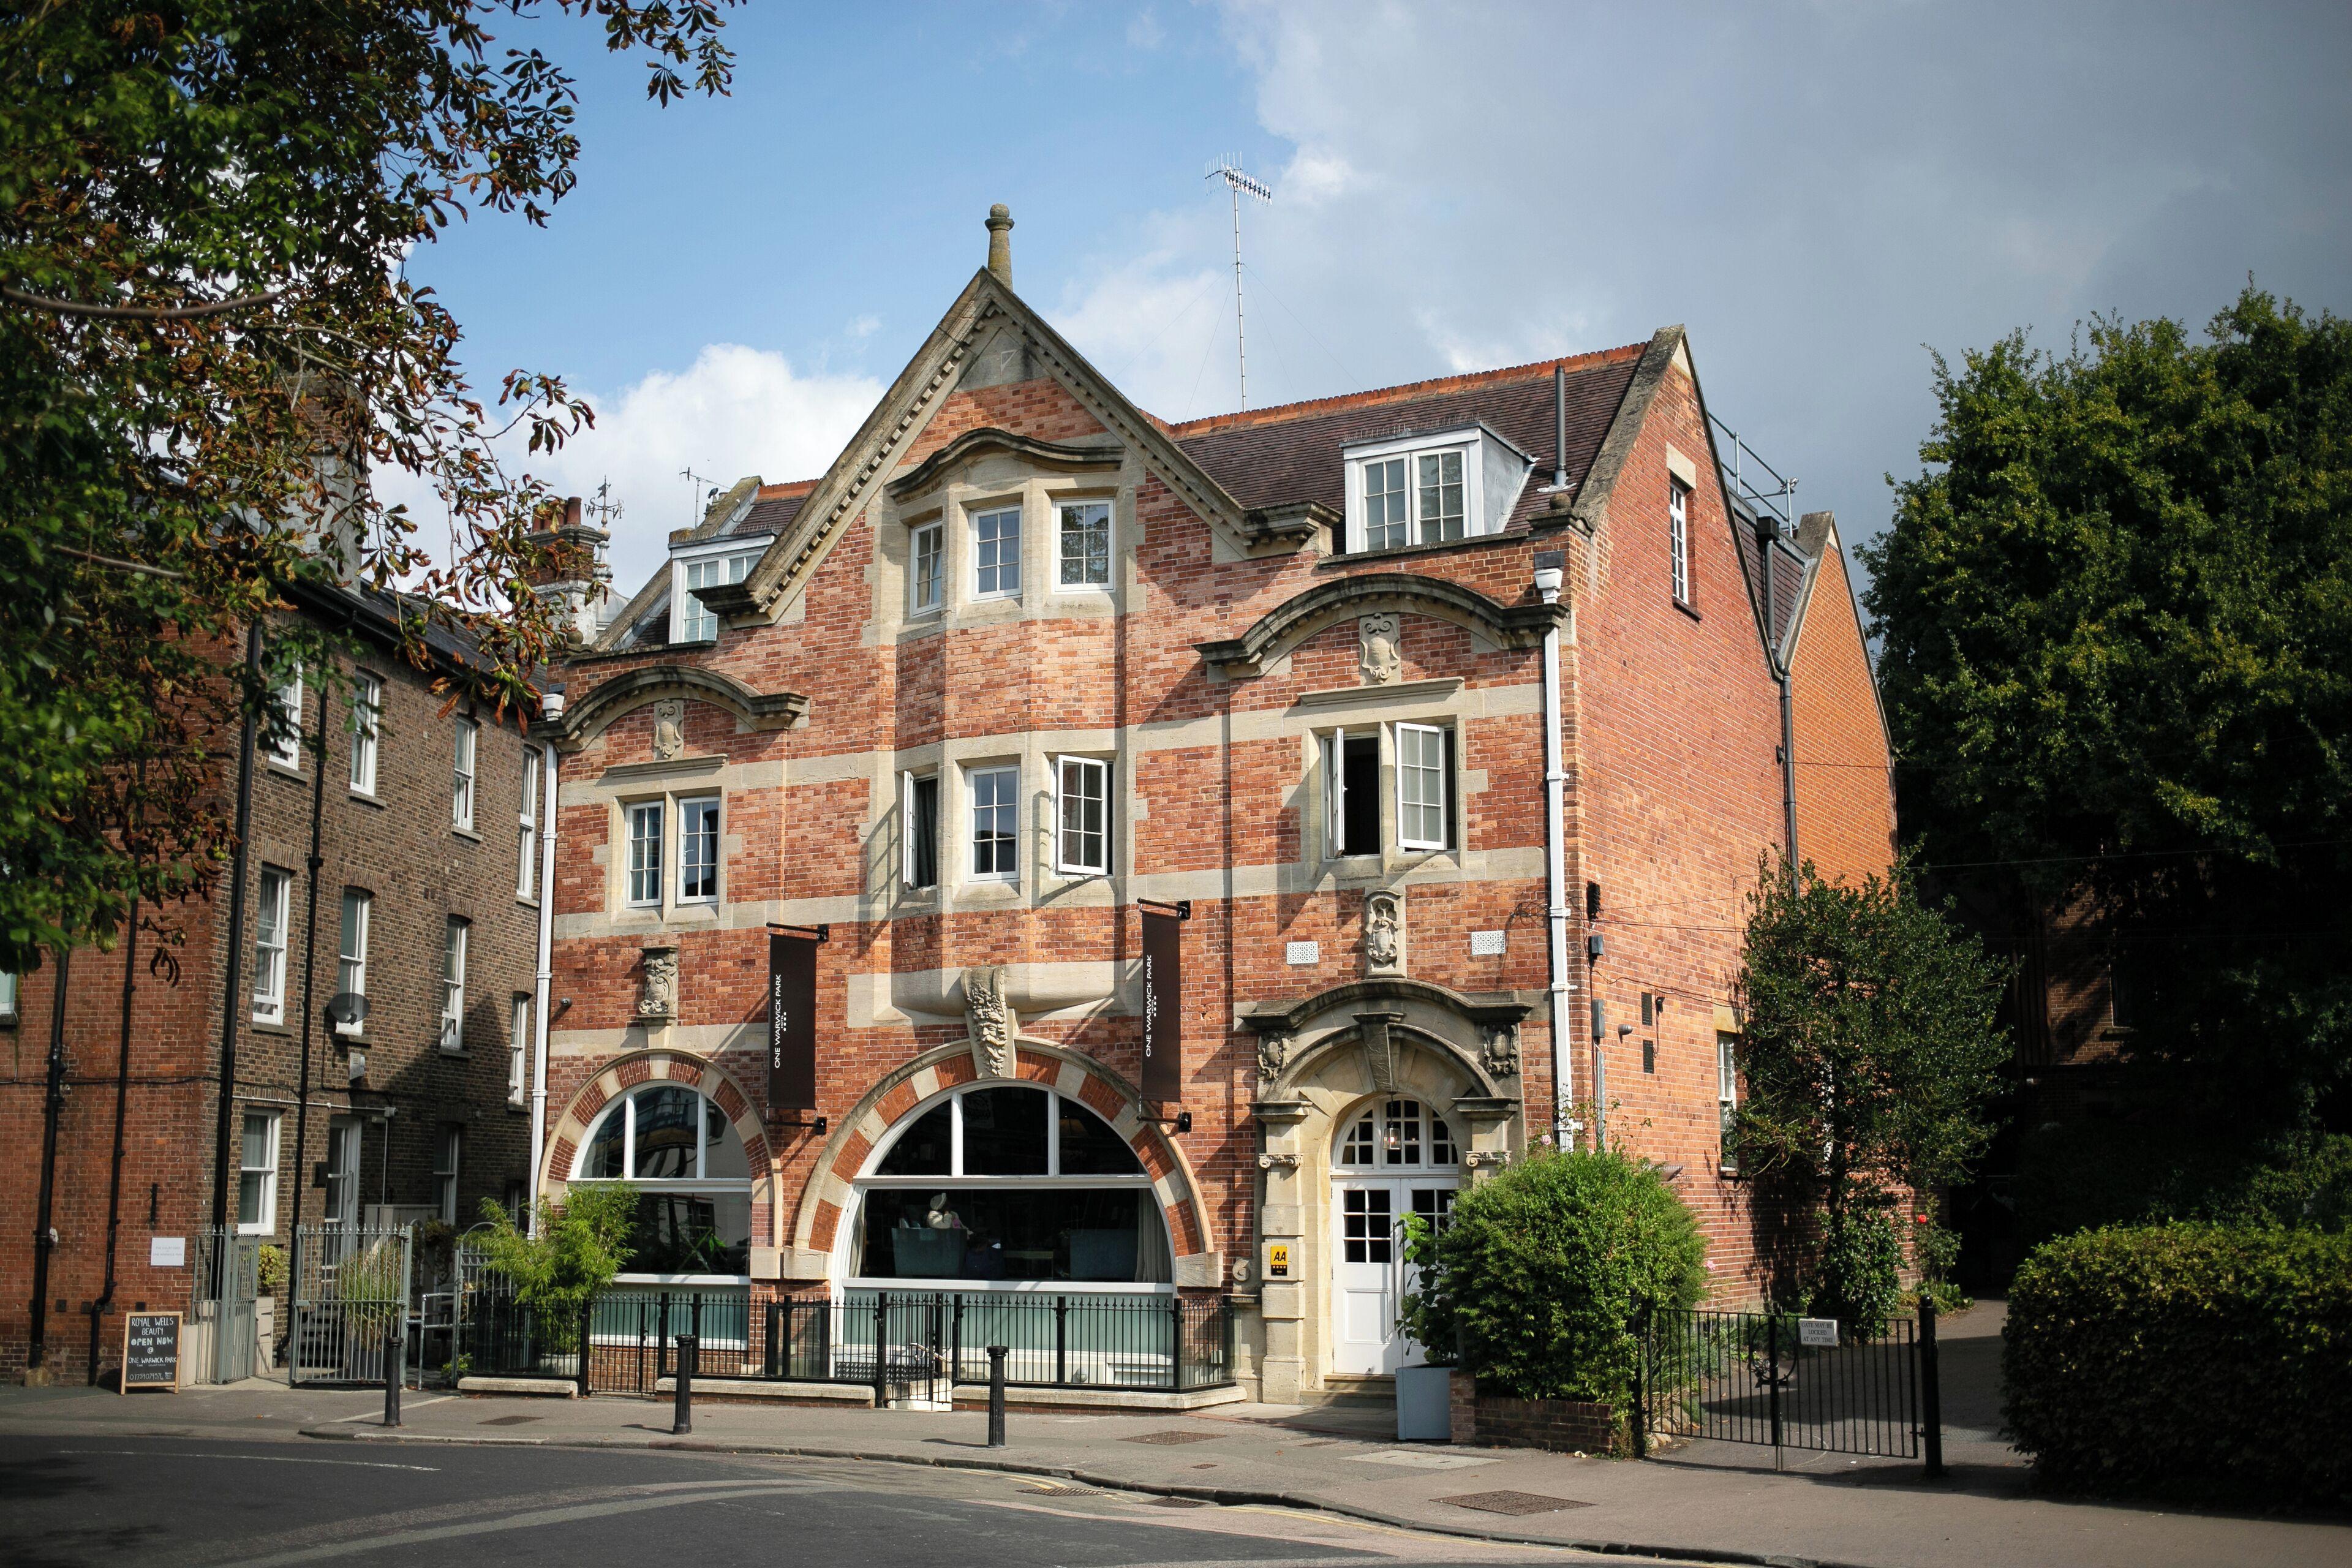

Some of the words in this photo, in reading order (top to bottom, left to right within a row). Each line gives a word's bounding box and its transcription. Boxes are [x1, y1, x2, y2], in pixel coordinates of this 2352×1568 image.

[1273, 1251, 1286, 1262] AA
[132, 1317, 151, 1327] ROYAL
[155, 1317, 174, 1326] WELLS
[156, 1336, 174, 1345] NOW
